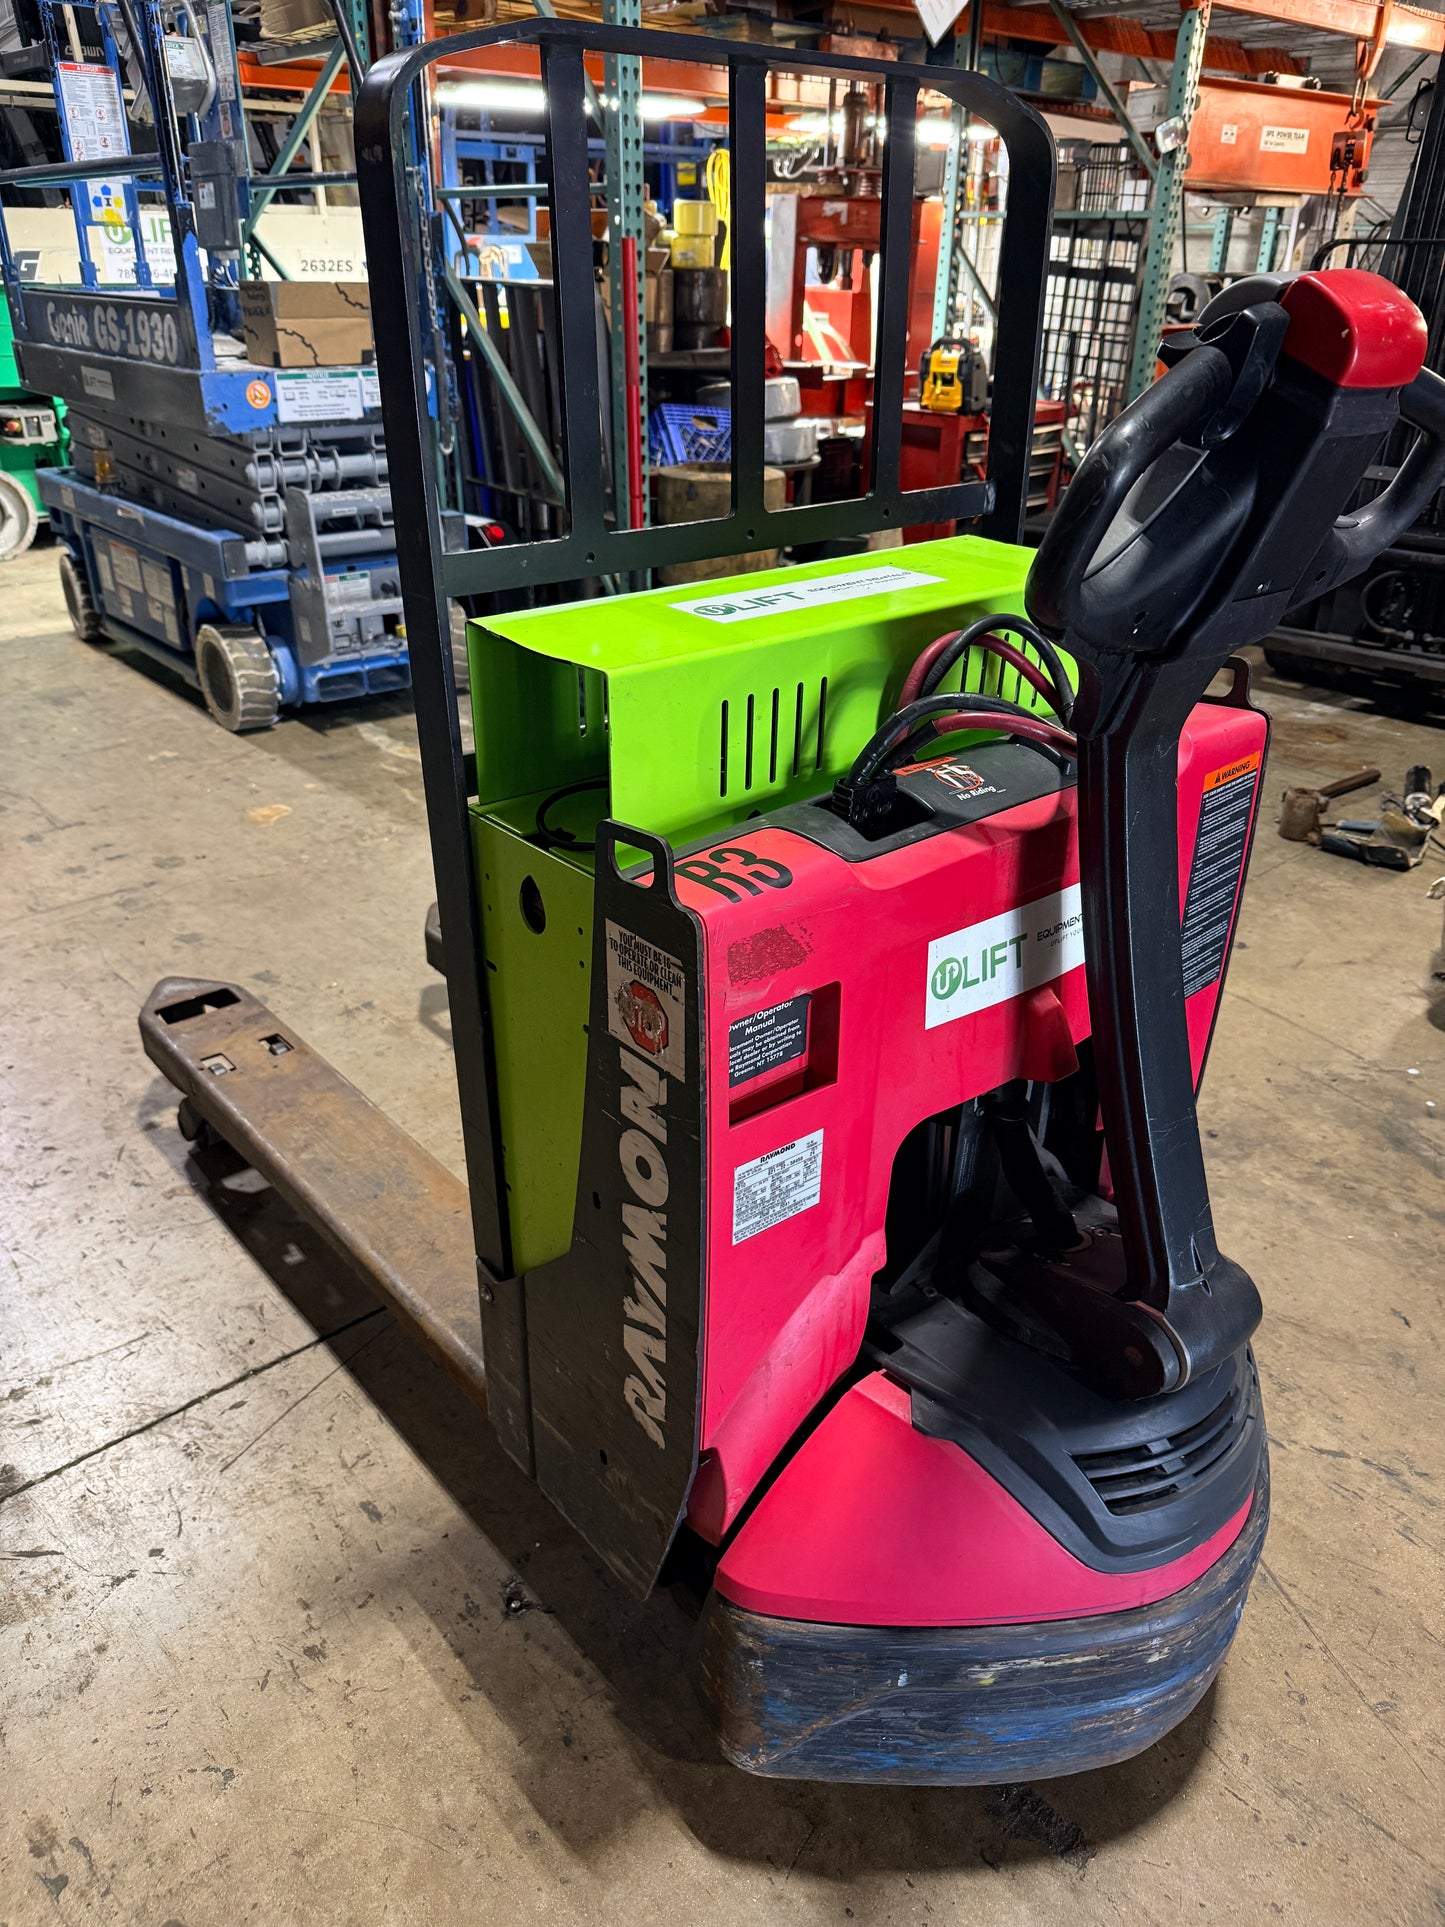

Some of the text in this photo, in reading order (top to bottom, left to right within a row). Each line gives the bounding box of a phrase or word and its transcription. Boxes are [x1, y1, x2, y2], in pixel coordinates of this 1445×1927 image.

[301, 260, 353, 272] 2632ES
[94, 304, 178, 364] GS-1930
[1221, 760, 1250, 781] WARNING
[957, 785, 997, 801] No Riding
[674, 847, 793, 903] R3
[618, 930, 633, 947] YOU
[653, 949, 663, 966] BE
[609, 936, 682, 989] TO OPERATE OR CLEAN
[617, 953, 674, 996] THIS EQUIPMENT
[745, 1015, 776, 1036] Manual
[755, 1039, 763, 1048] be
[763, 1030, 786, 1044] obtained
[787, 1024, 800, 1033] from
[735, 1055, 761, 1071] Raymond
[761, 1041, 793, 1058] Corporation
[743, 1050, 761, 1060] dealer
[756, 1059, 766, 1068] NY
[760, 1143, 796, 1163] RAYMOND
[619, 1046, 670, 1450] RAYMON
